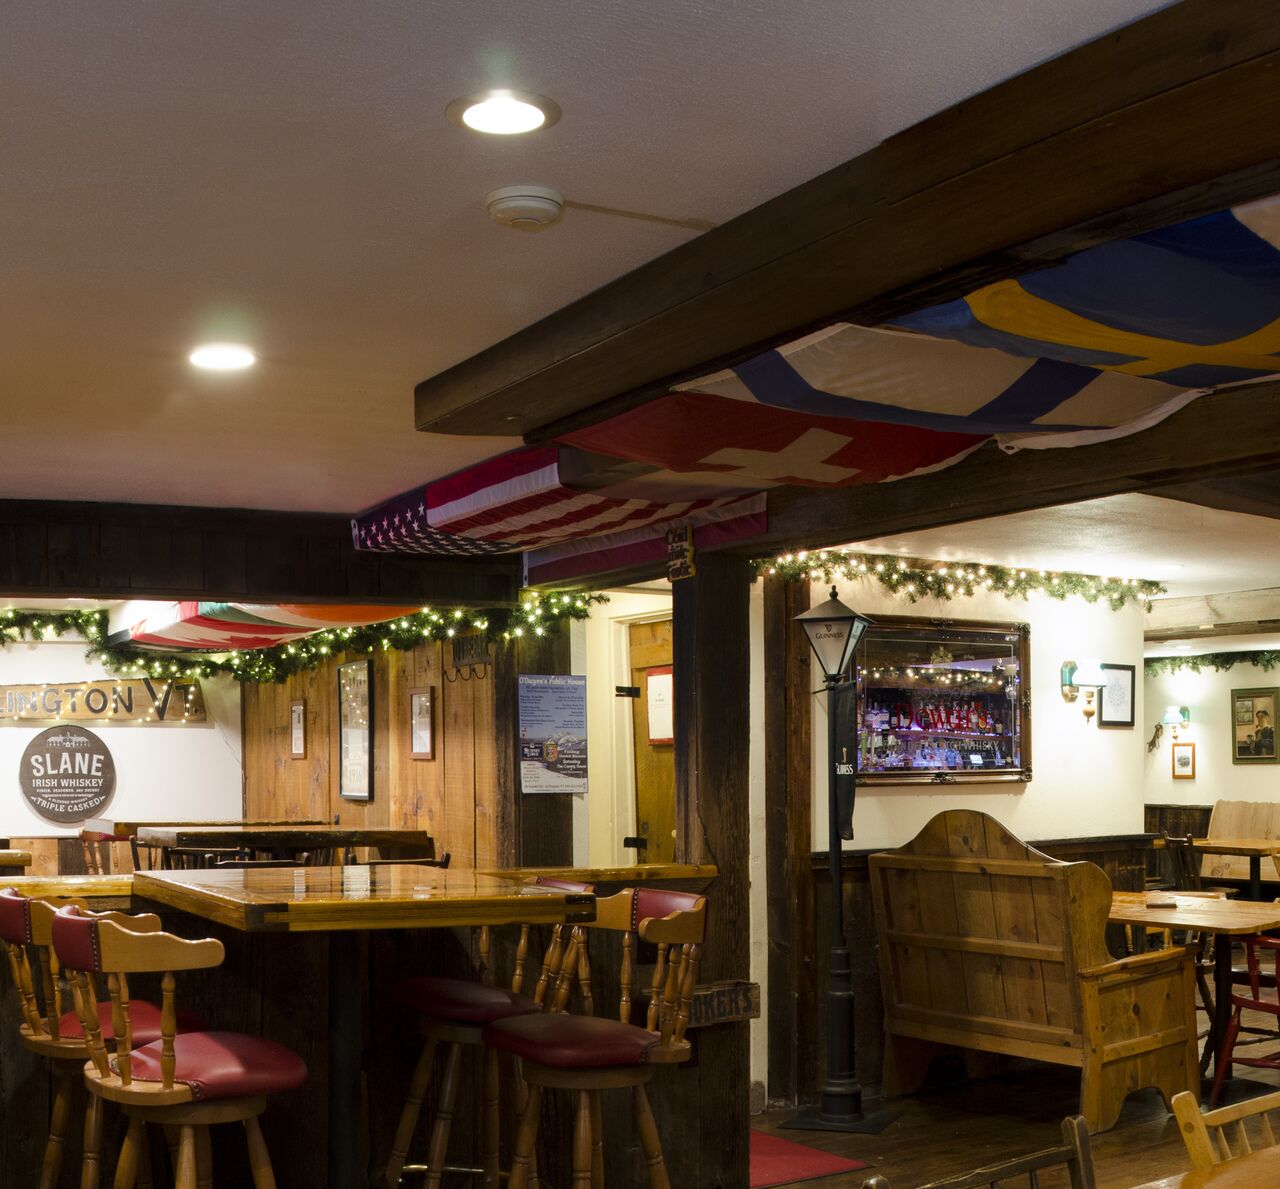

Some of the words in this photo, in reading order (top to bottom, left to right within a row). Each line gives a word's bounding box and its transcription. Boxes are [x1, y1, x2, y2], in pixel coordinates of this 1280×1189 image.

[815, 632, 844, 640] GUINNESS
[30, 752, 105, 777] SLANE
[32, 778, 58, 788] IRISH
[60, 778, 105, 788] WHISKEY
[37, 797, 65, 812] TRIPLE
[67, 797, 100, 812] CASKED
